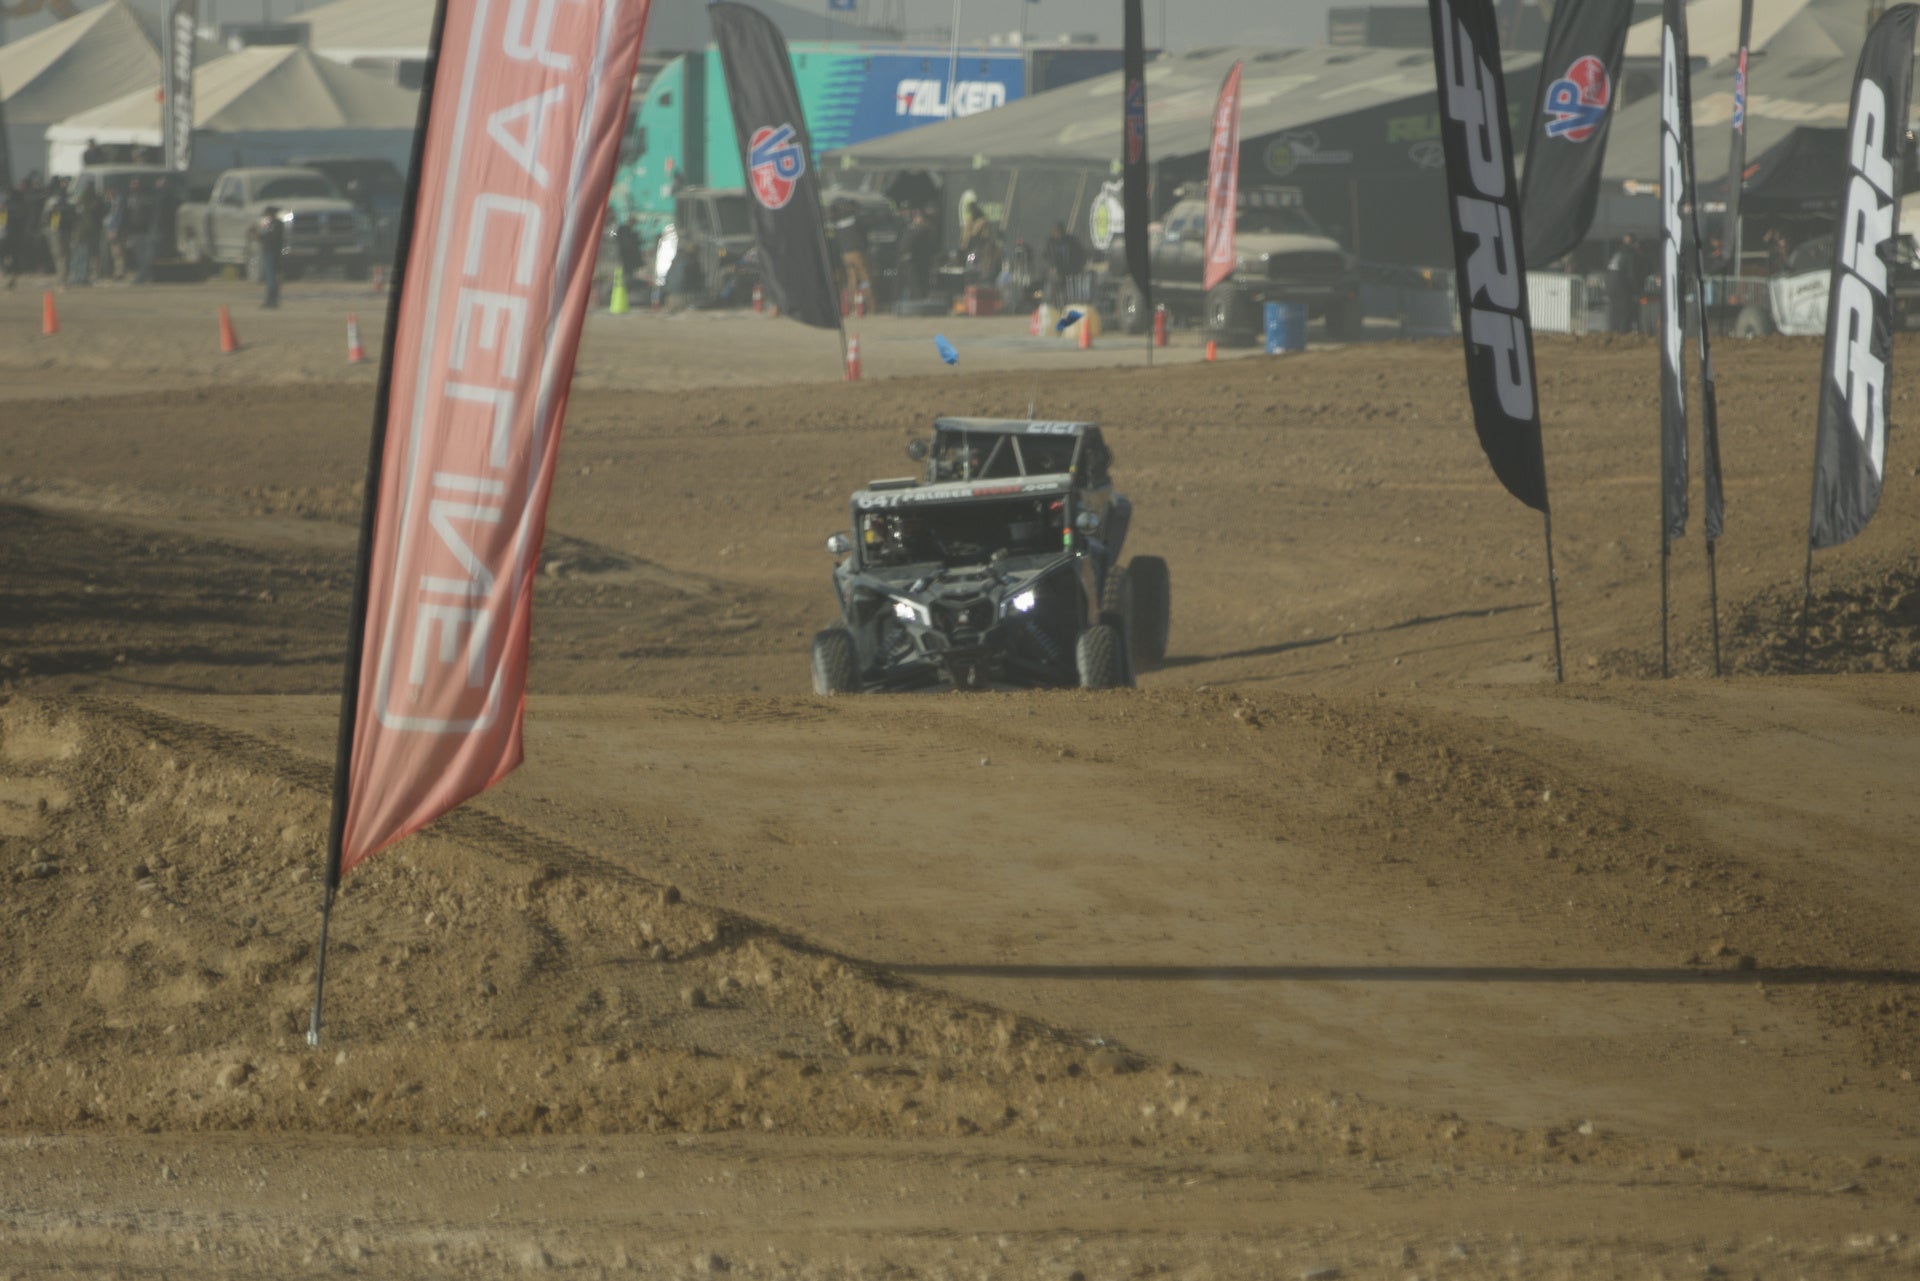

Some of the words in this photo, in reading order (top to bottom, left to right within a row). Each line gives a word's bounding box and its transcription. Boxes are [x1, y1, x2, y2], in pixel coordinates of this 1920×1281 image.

[895, 79, 1006, 118] FALKEN
[1543, 79, 1606, 138] VP
[750, 122, 806, 180] VP
[1440, 0, 1533, 421] PRP
[1832, 78, 1893, 484] PRP
[857, 493, 900, 509] 647
